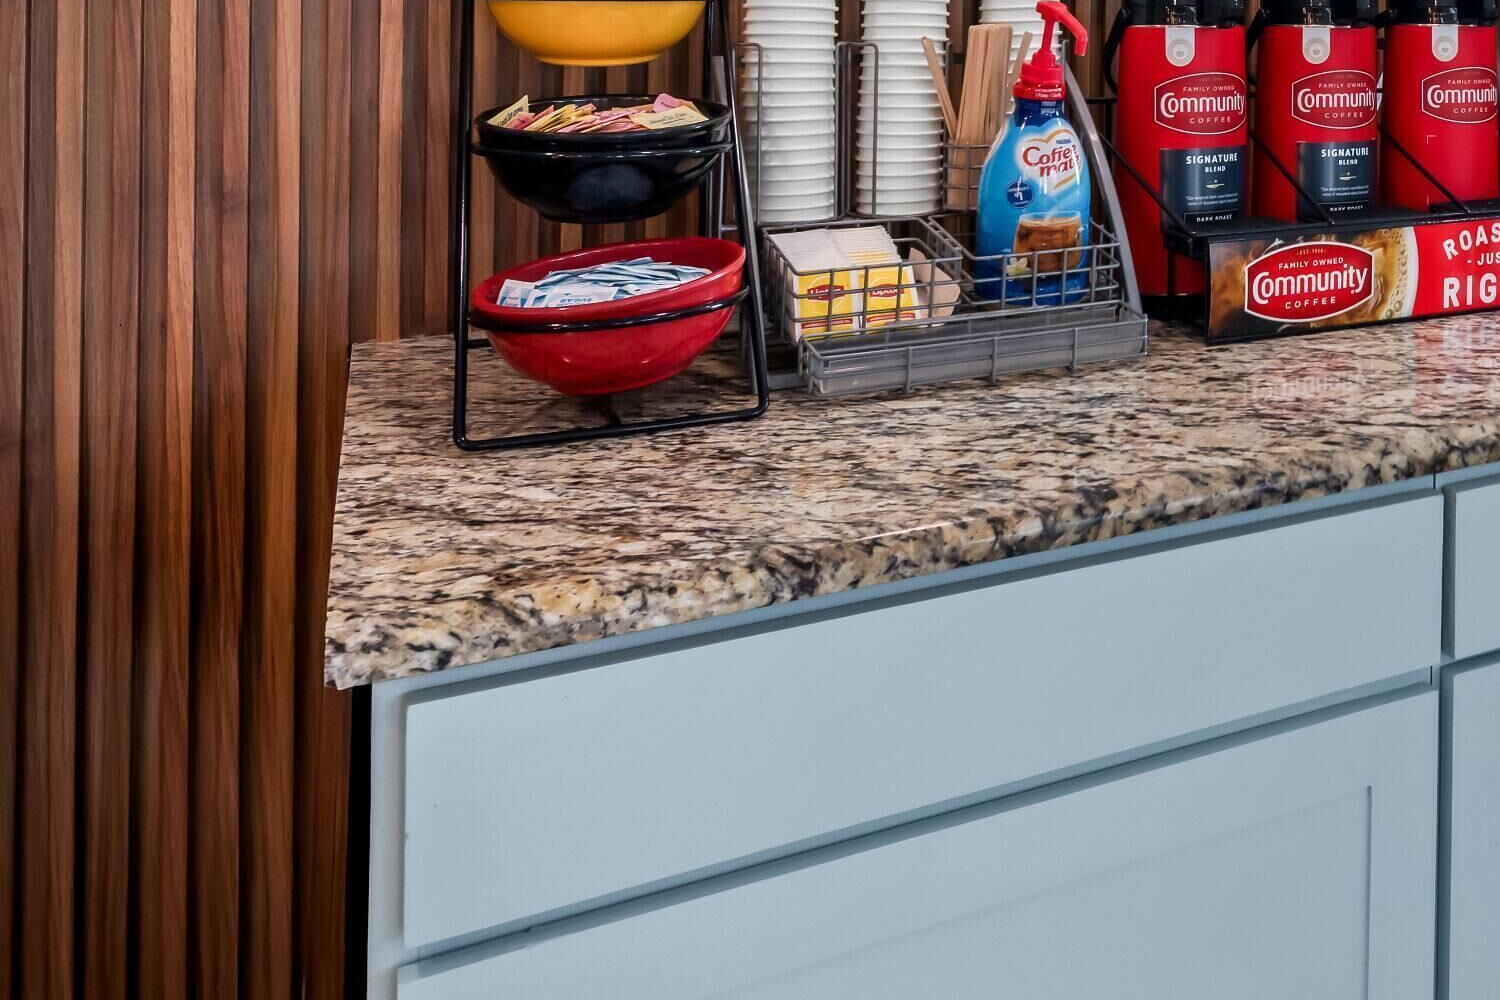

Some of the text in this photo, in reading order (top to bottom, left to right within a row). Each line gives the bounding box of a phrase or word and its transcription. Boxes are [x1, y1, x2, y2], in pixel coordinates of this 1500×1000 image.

[1297, 88, 1376, 113] Community
[1427, 83, 1497, 109] Community
[1160, 91, 1245, 119] Community
[1189, 116, 1232, 124] COFFEE
[1324, 111, 1364, 119] COFFEE
[1186, 152, 1238, 165] SIGNATURE
[1321, 147, 1369, 158] SIGNATURE
[1205, 165, 1226, 173] BLEND
[1278, 257, 1344, 270] FAMILY OWNED
[1252, 263, 1368, 304] Community
[1285, 296, 1336, 309] COFFEE
